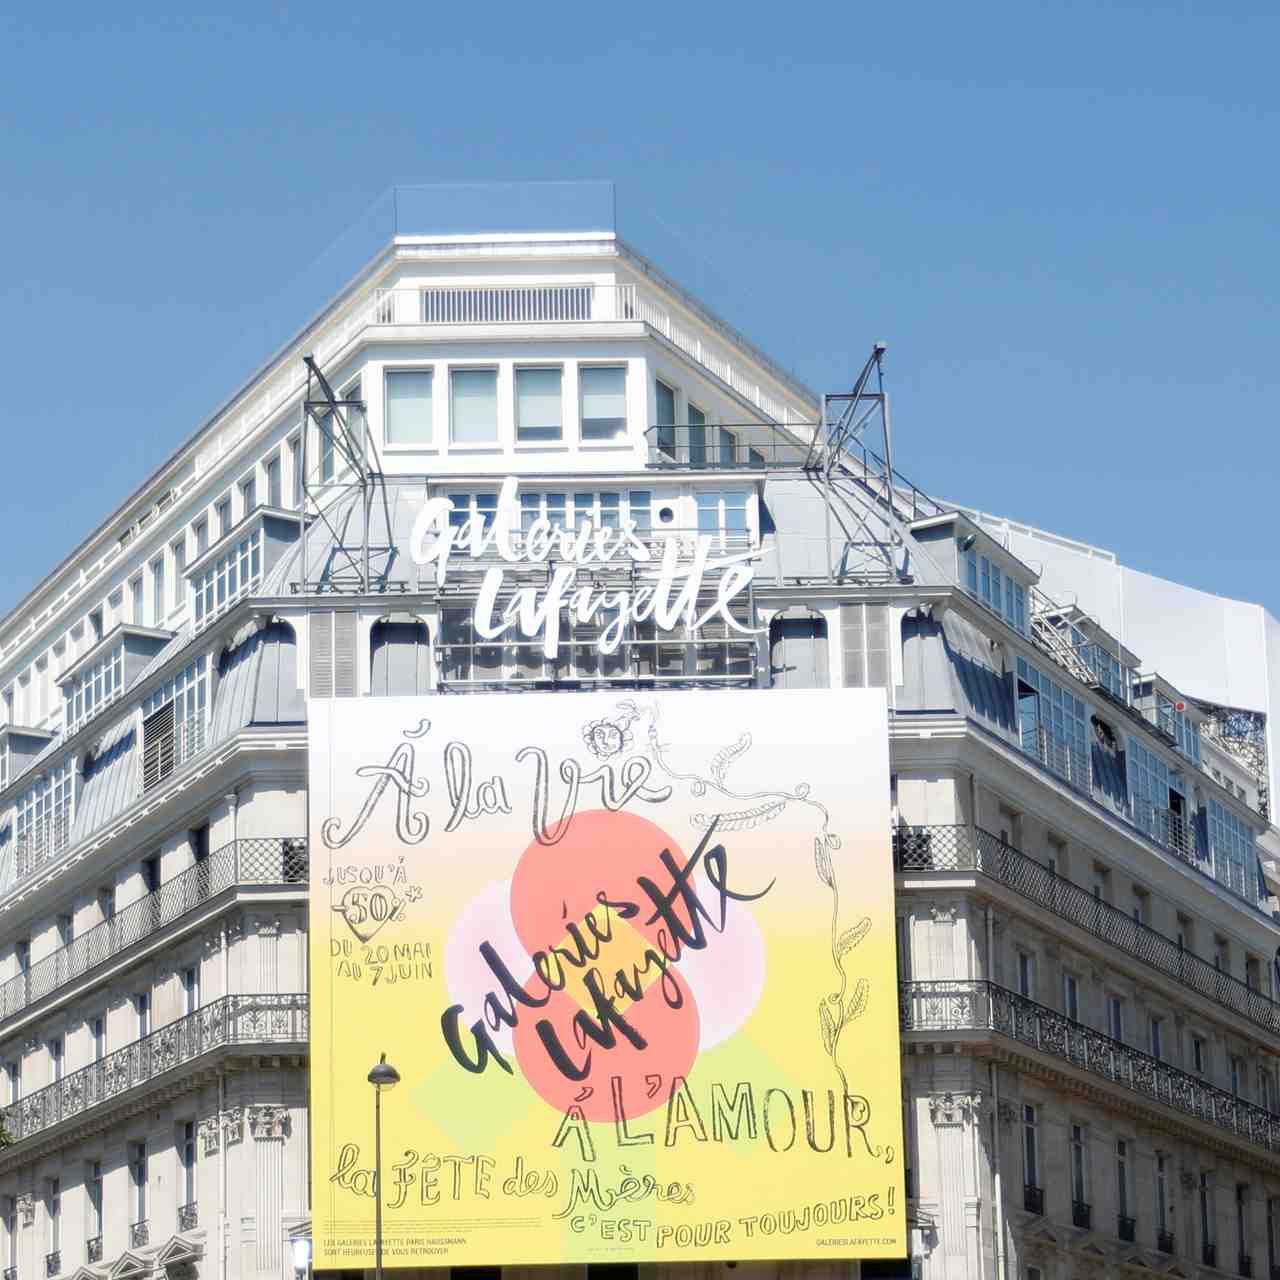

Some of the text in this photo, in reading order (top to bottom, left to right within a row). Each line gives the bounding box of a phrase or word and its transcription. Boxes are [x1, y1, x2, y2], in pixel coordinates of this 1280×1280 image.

[410, 476, 652, 585] Galeries
[475, 536, 776, 659] Lafayette
[443, 741, 513, 833] la
[515, 746, 674, 846] Vie
[330, 938, 432, 965] DU 20 MAI
[337, 960, 433, 986] AU 7 JUIN
[440, 890, 640, 1075] Galeries
[535, 814, 777, 1081] Lafayette
[616, 1074, 896, 1165] L'AMOUR,
[329, 1143, 559, 1209] la FÊTE des
[552, 1157, 695, 1220] Mères
[570, 1215, 652, 1242] C'EST
[656, 1223, 731, 1249] POUR
